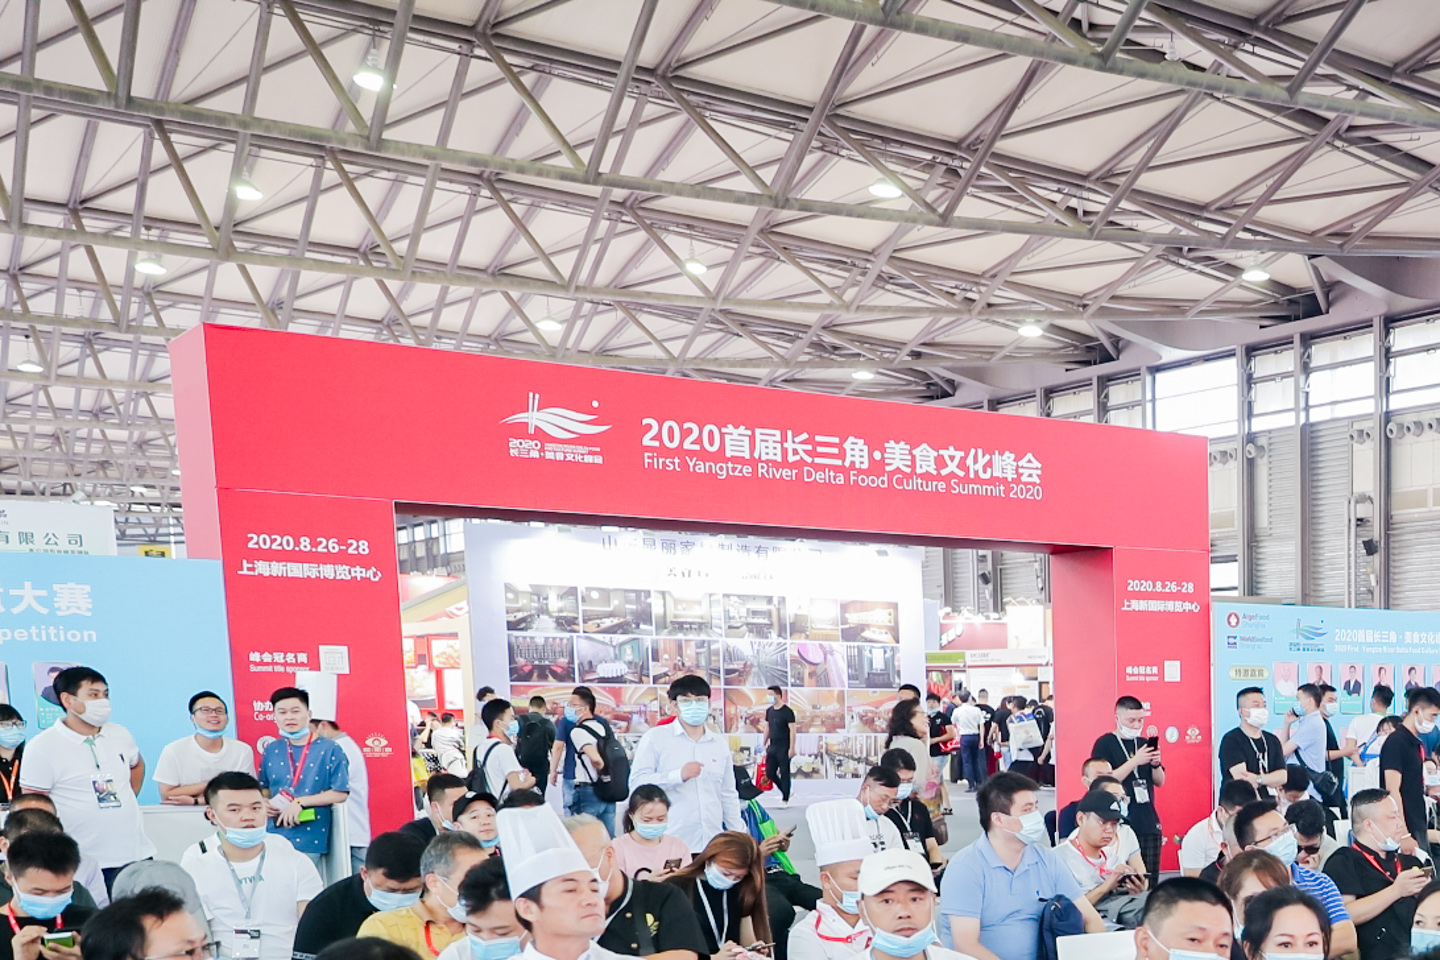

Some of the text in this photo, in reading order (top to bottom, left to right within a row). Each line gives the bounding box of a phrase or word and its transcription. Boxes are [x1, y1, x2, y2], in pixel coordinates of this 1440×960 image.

[508, 438, 541, 449] 2020
[641, 417, 1043, 485] 2020首届长三角·美食文化峰会
[644, 452, 1043, 500] First Yangtze River Delta Food Culture Summit 2020
[246, 533, 370, 556] 2020.8.26-28
[236, 559, 382, 582] 上海新国际博览中心
[1126, 579, 1194, 593] 2020.8.26-28
[0, 581, 93, 617] 大赛
[1121, 599, 1200, 613] 上海新国际博览中心
[249, 651, 308, 664] 峰会冠名商
[249, 664, 273, 672] Summit
